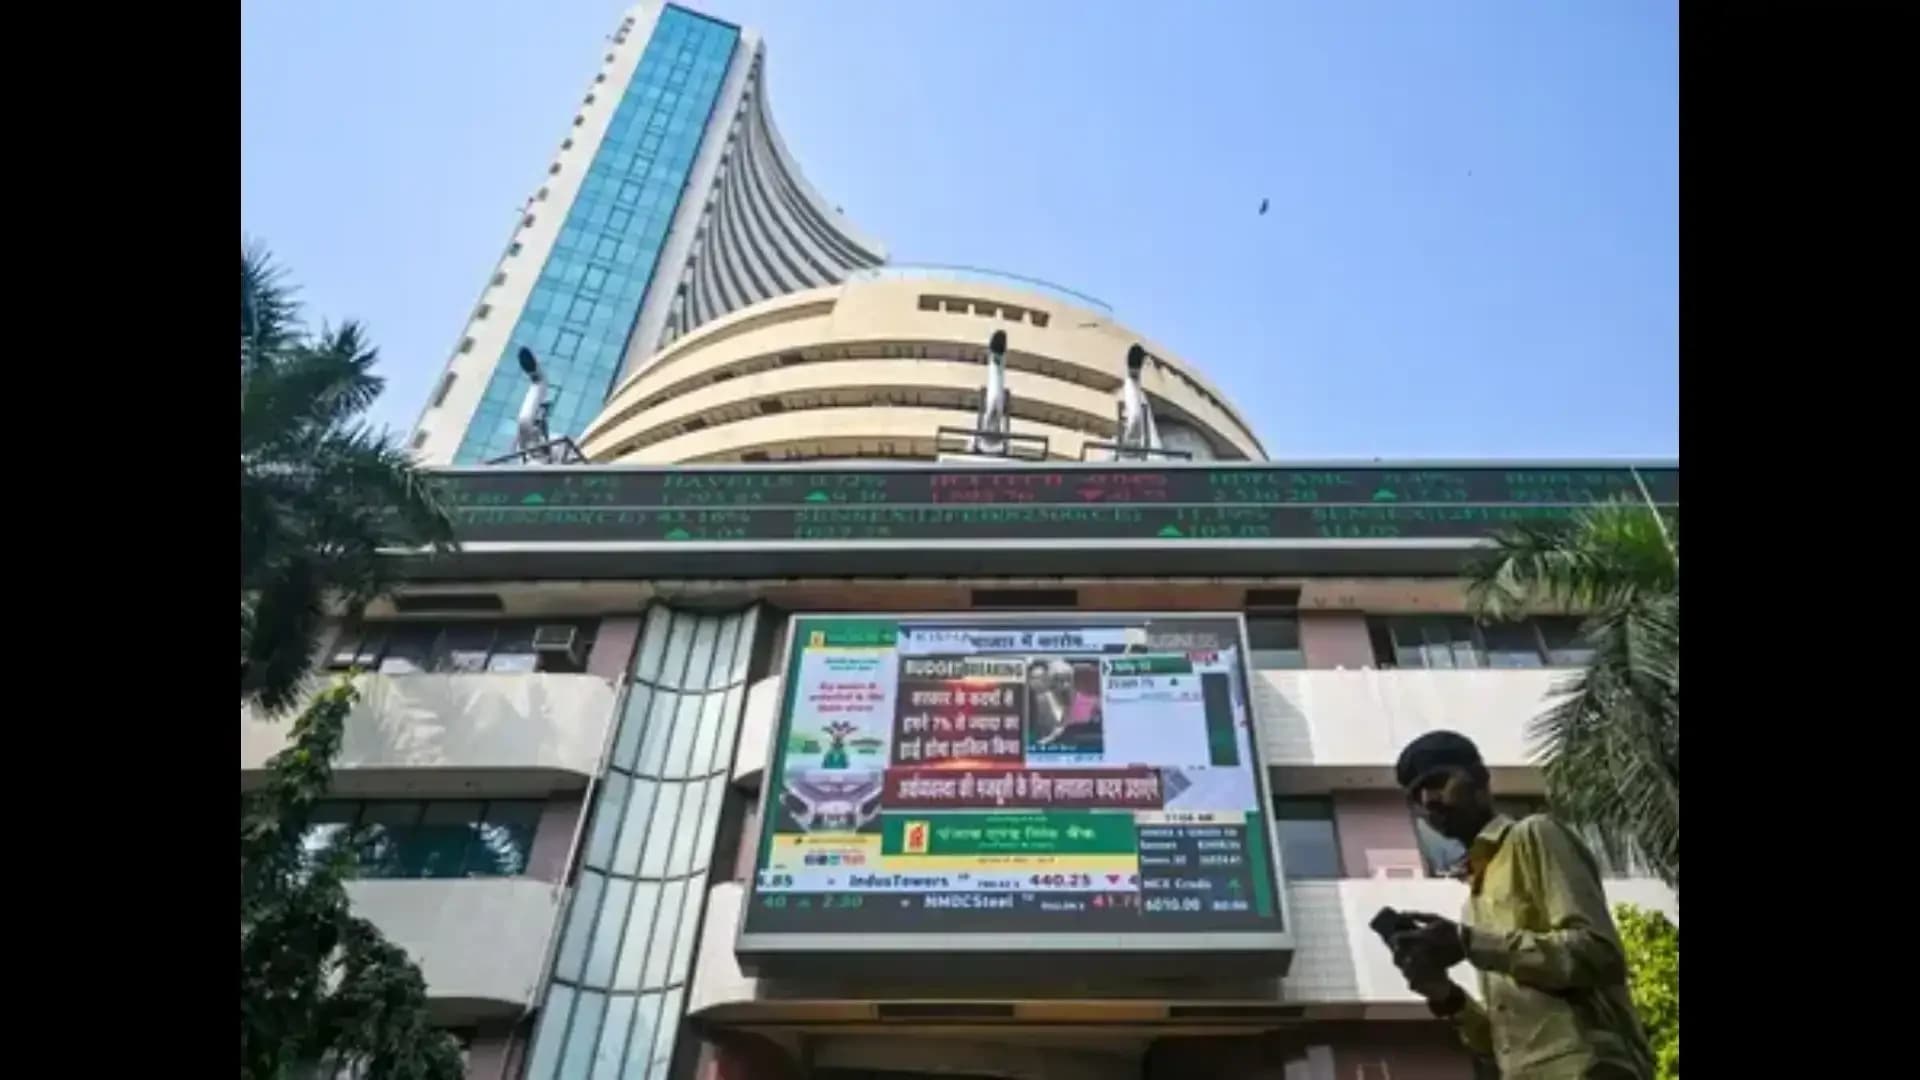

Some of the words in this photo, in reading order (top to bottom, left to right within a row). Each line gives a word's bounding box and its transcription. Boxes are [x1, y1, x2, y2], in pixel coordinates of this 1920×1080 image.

[848, 873, 950, 889] IndusTowers
[1029, 873, 1092, 888] 440.25
[923, 891, 1014, 909] NMDCSteel
